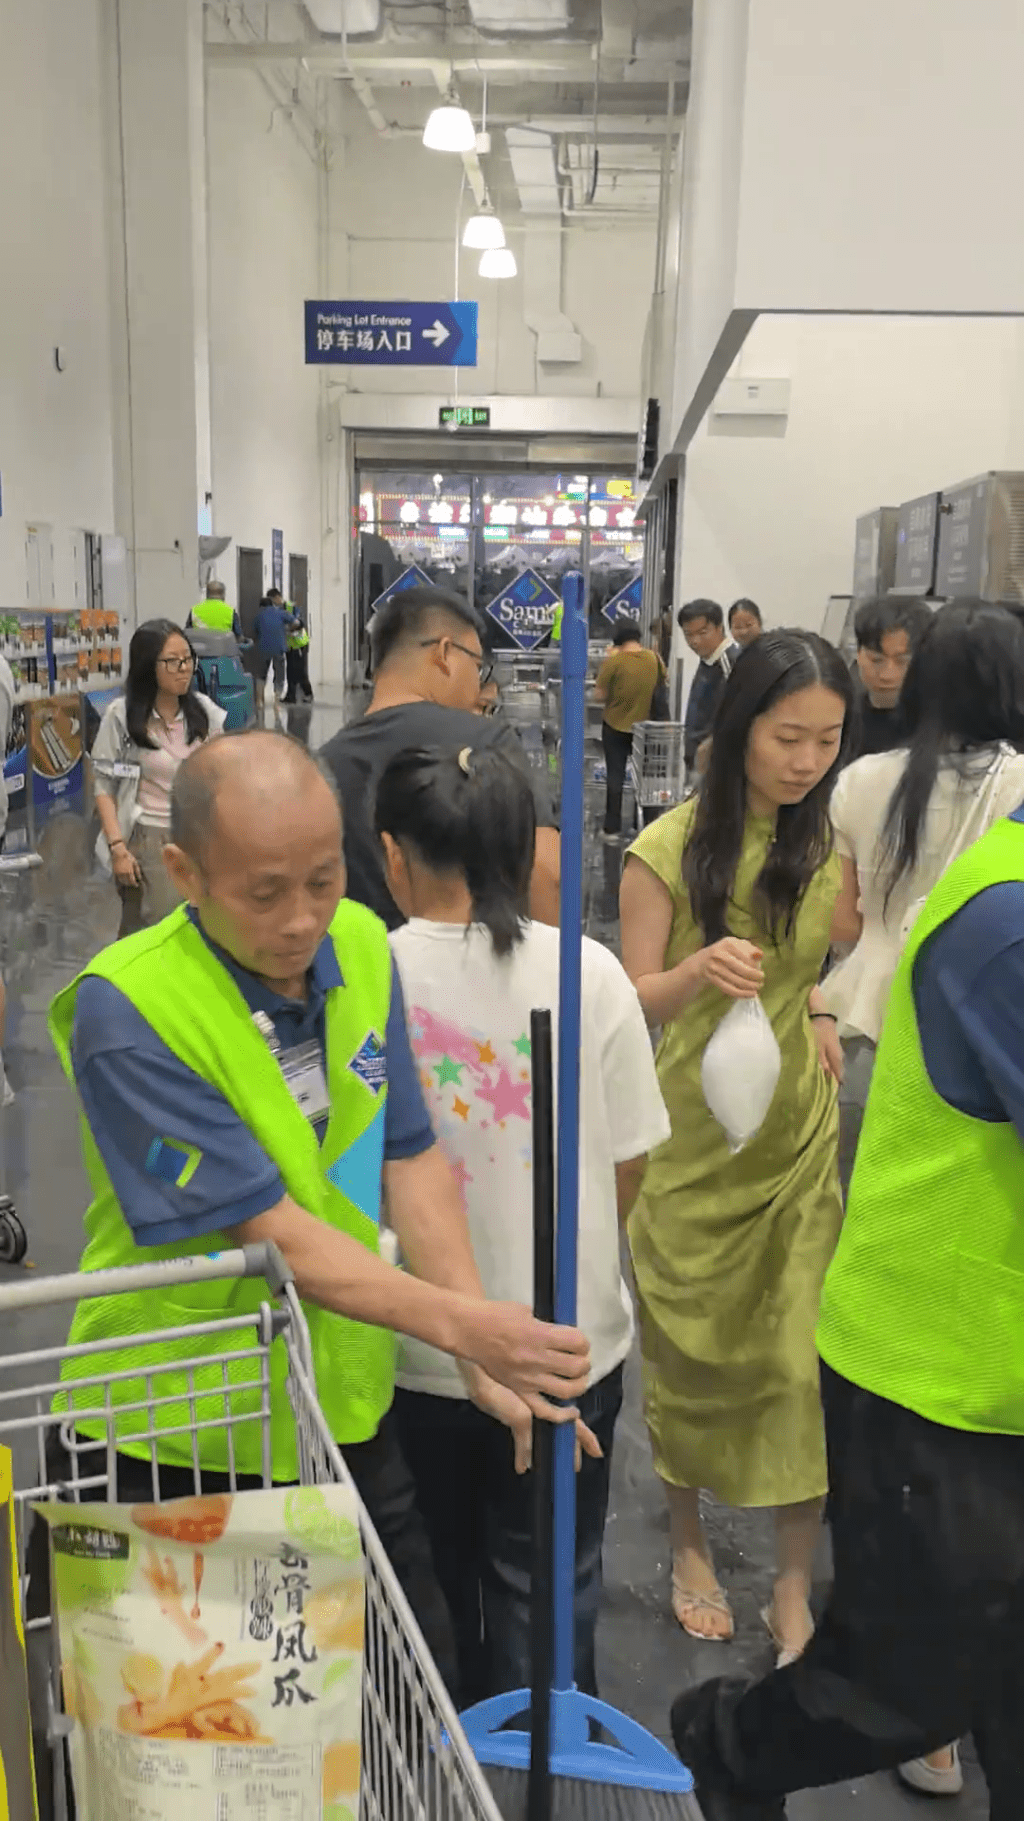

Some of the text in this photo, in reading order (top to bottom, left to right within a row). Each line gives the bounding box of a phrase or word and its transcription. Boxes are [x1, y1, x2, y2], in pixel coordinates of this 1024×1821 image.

[317, 313, 412, 327] Parking Lot Entrance
[317, 329, 412, 351] 停车场入口
